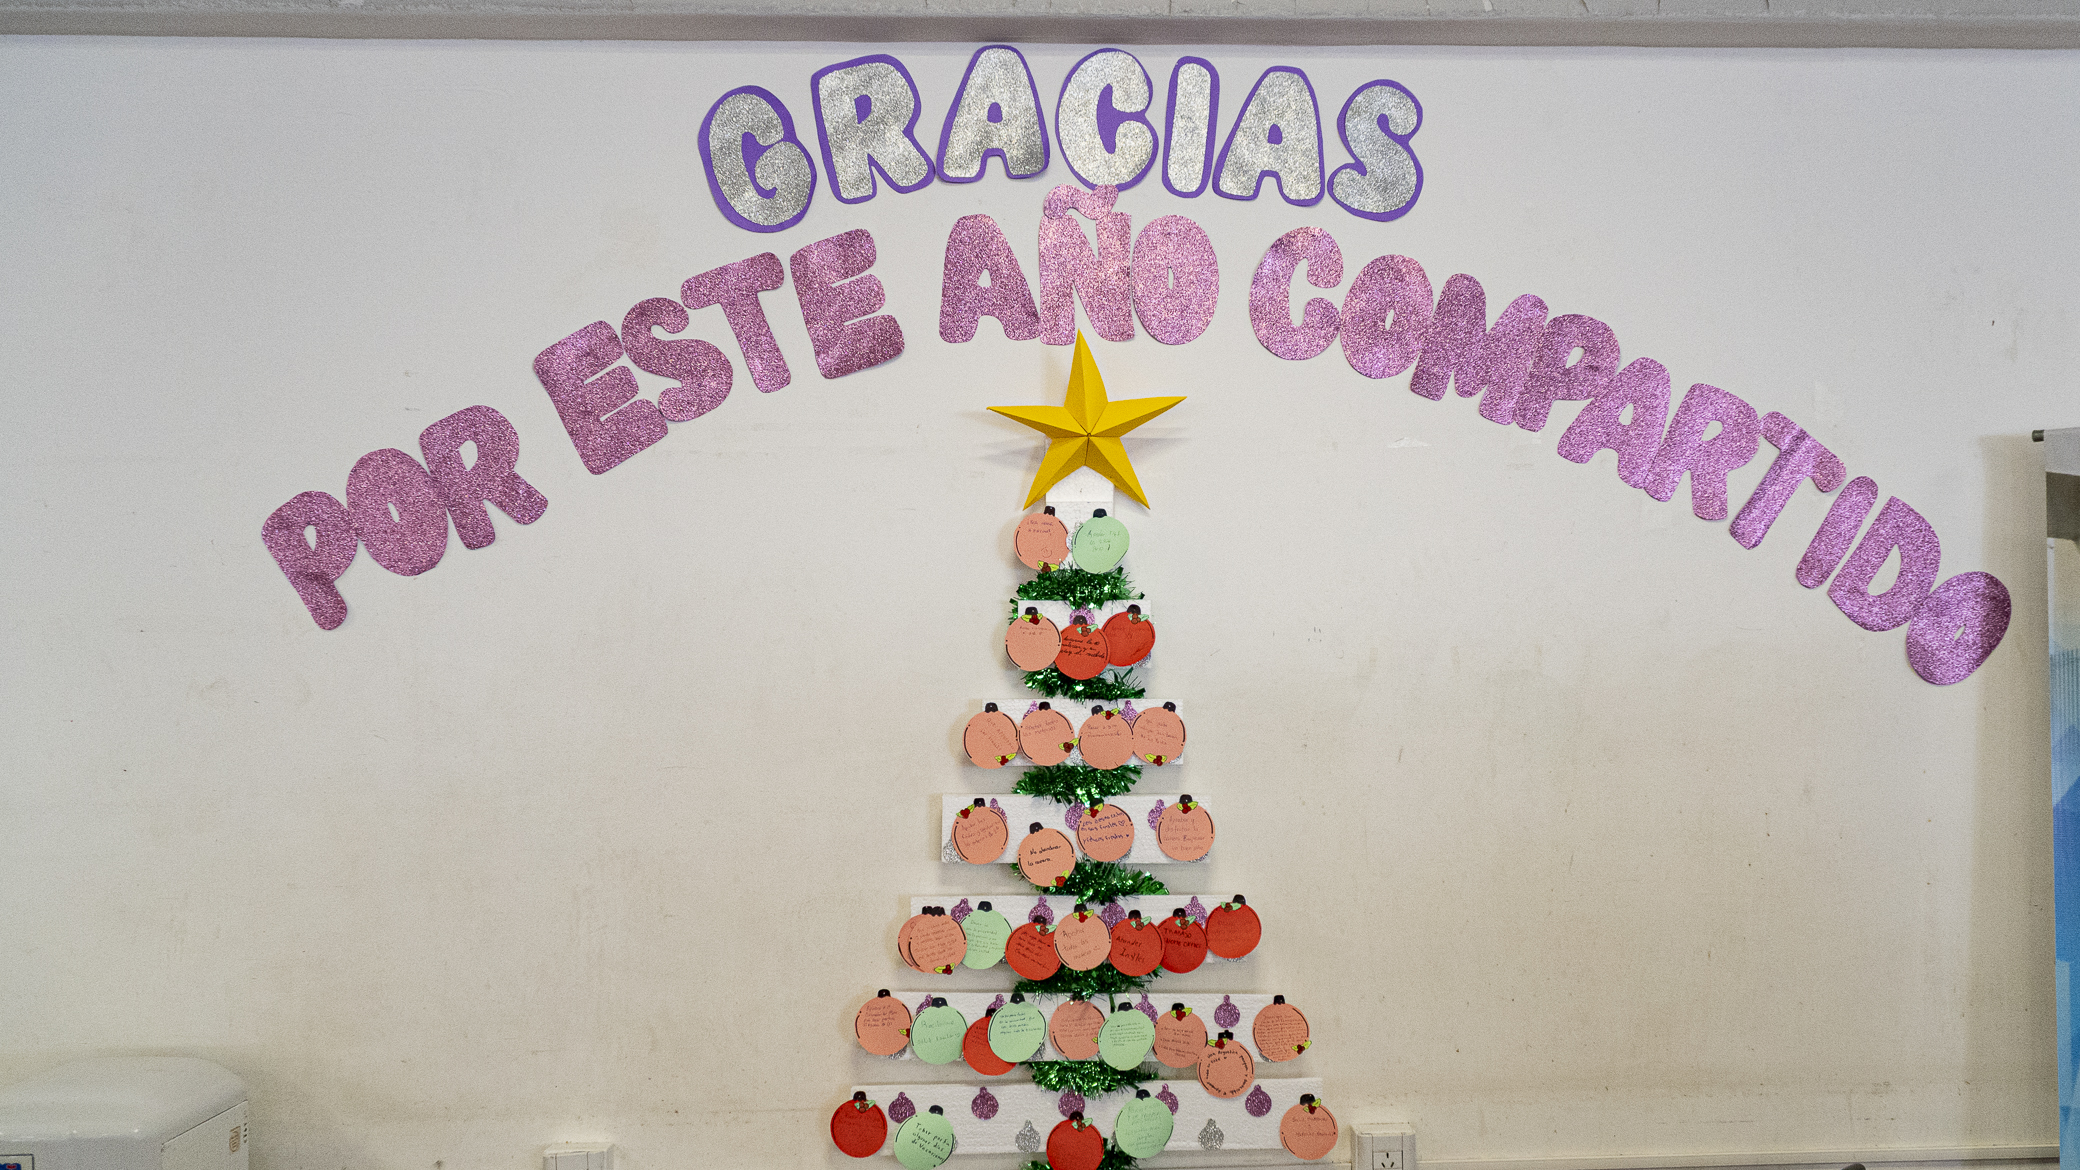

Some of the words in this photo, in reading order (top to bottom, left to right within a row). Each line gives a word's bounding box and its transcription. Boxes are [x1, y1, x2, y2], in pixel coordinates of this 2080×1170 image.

[698, 45, 1424, 234] GRACIAS
[261, 405, 549, 631] POR
[533, 228, 905, 476] ESTE
[939, 184, 1220, 346] AÑO
[1249, 226, 2012, 686] COMPARTIDO
